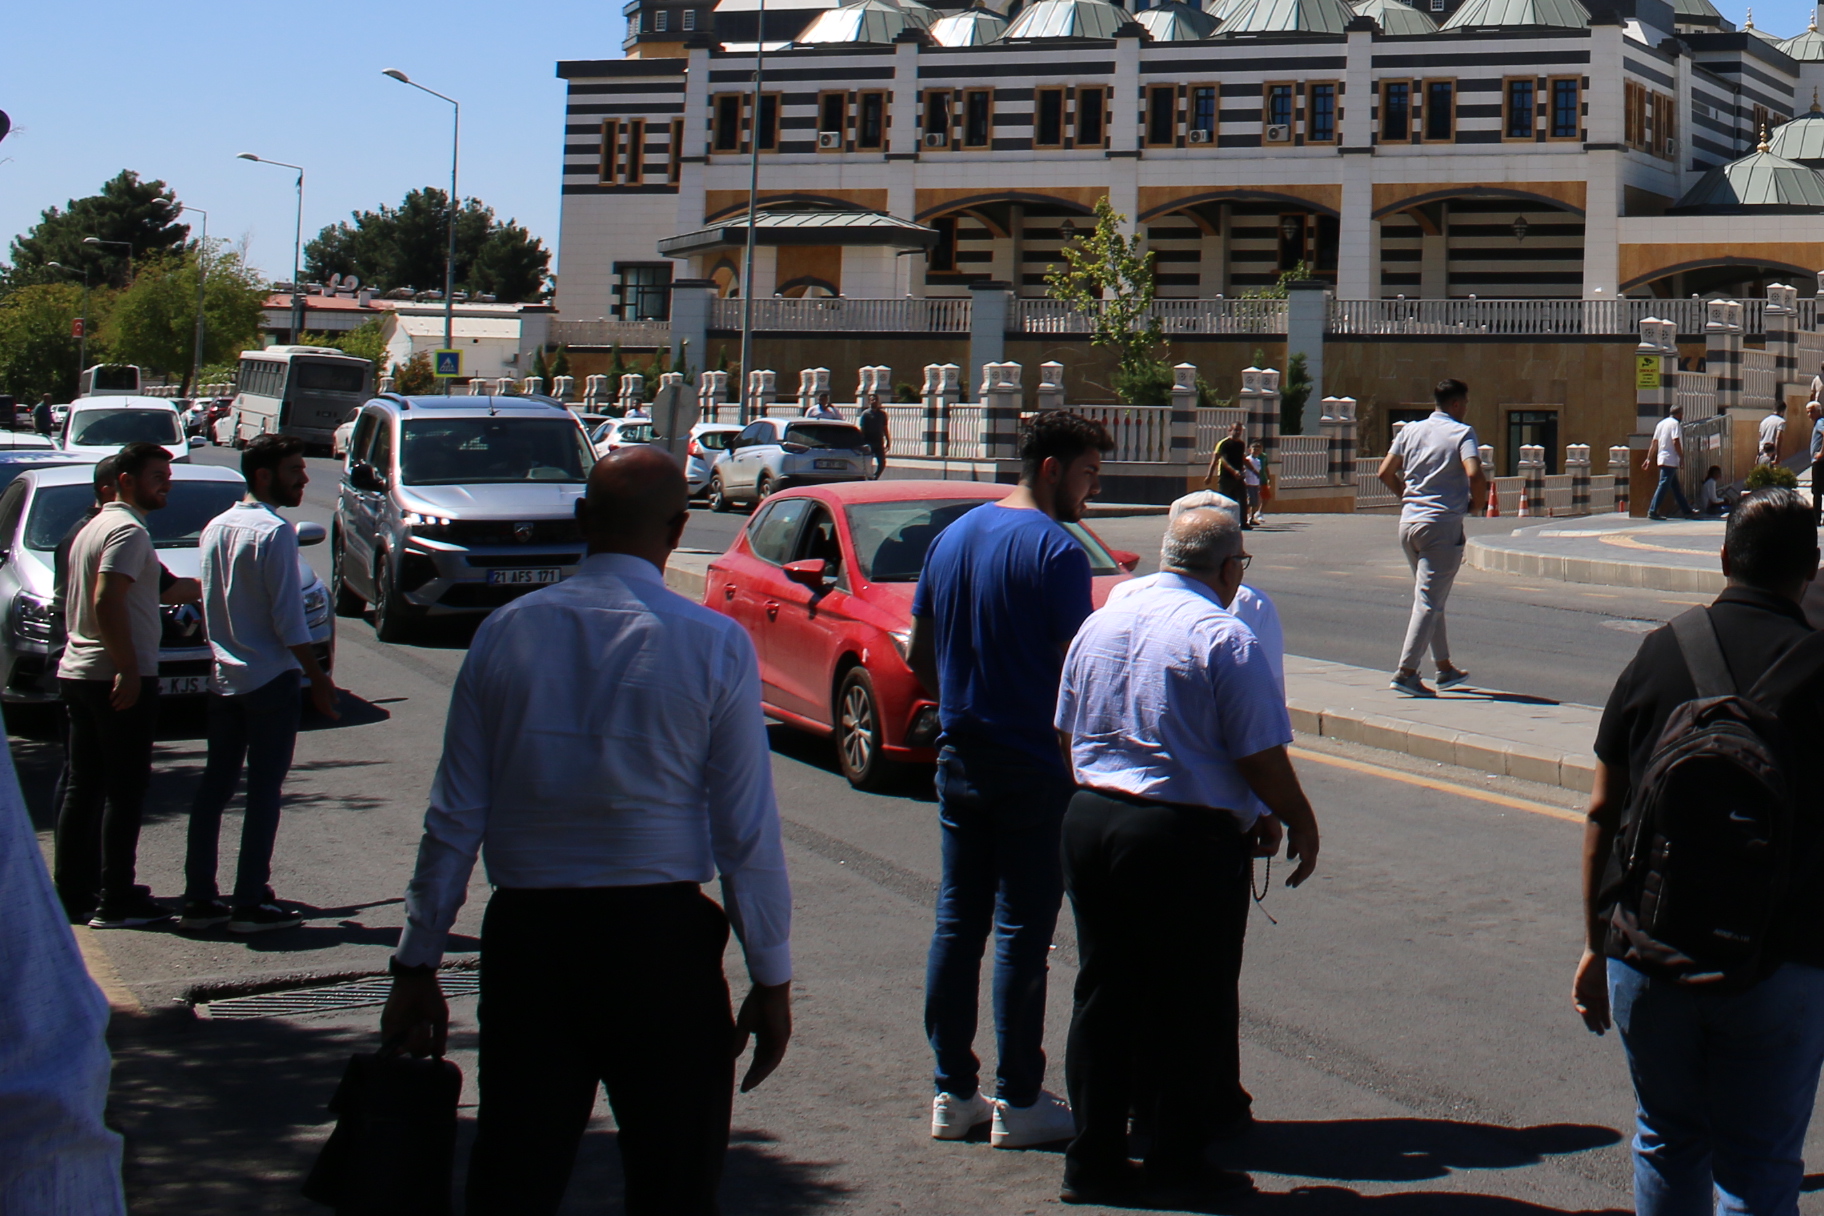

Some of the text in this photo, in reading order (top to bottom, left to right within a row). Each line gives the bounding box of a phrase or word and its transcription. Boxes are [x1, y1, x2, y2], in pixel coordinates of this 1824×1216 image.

[494, 570, 554, 583] 21 AFS 171
[171, 678, 199, 693] KJS
